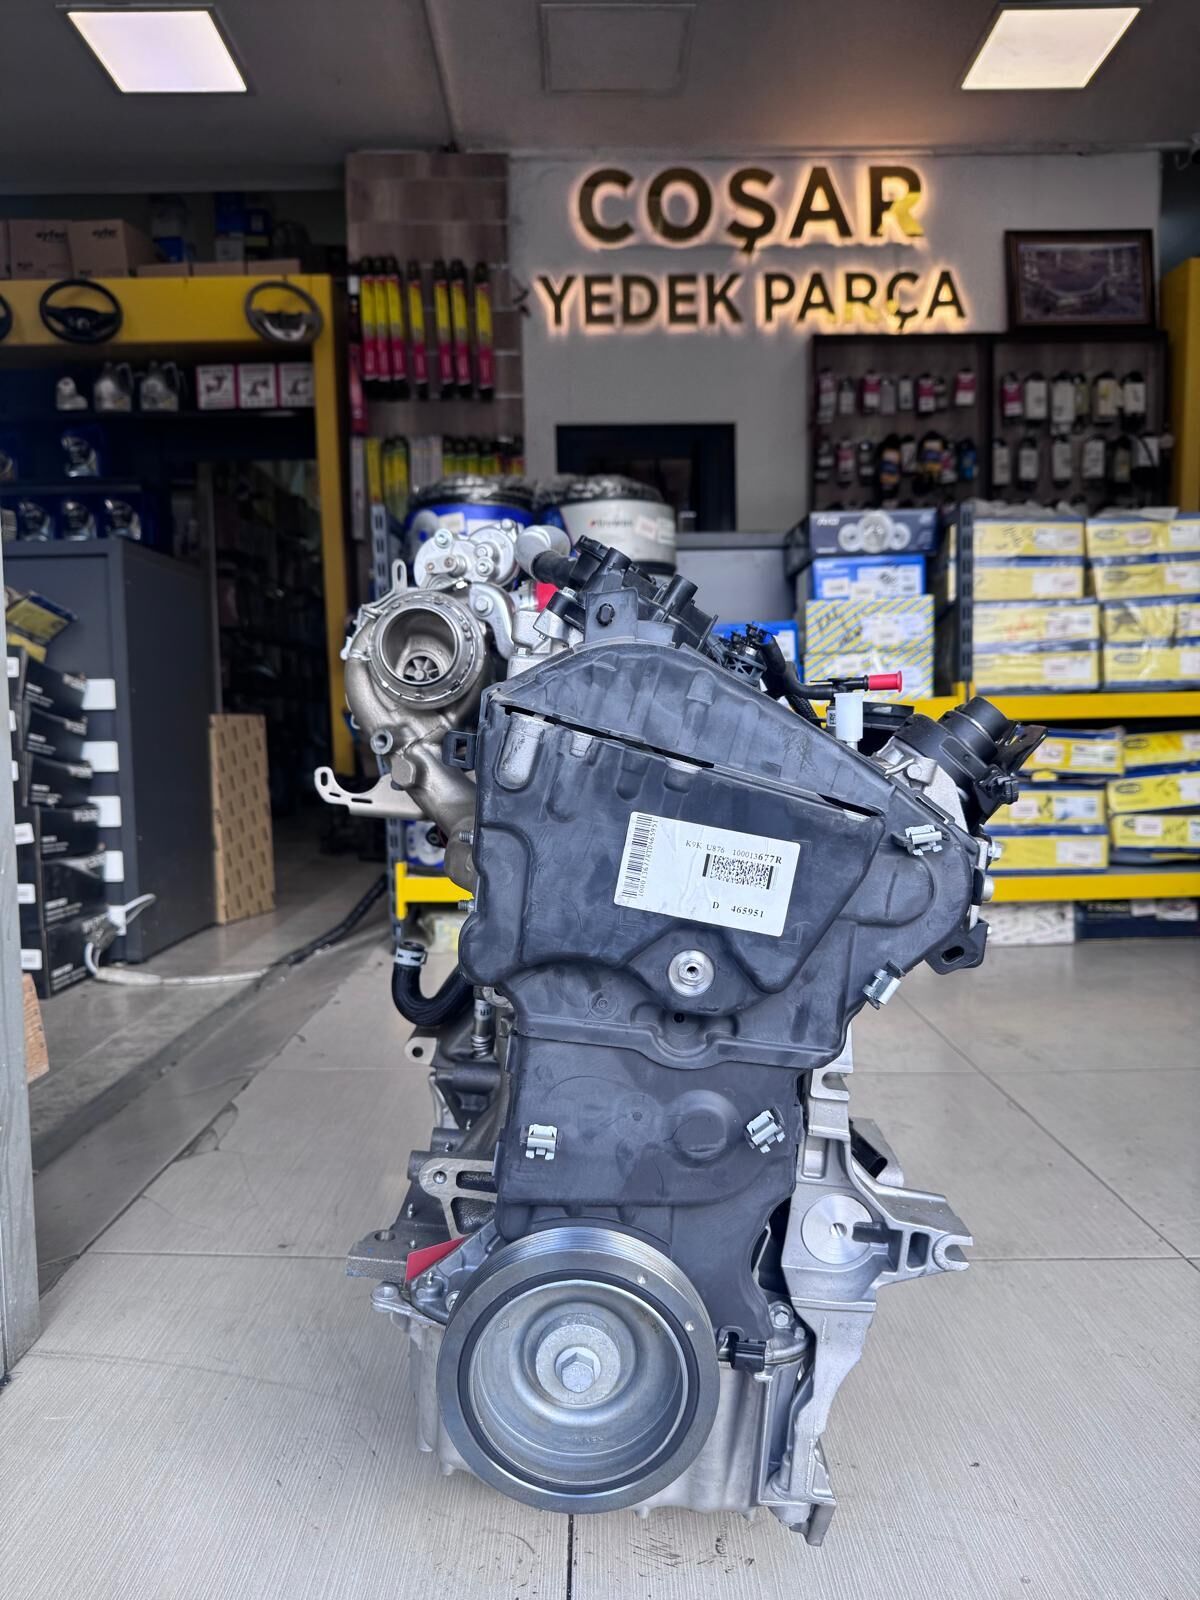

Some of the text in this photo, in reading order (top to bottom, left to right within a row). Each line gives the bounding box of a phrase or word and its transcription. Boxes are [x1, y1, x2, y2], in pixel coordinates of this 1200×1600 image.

[578, 166, 924, 254] COŞAR
[538, 271, 966, 331] YEDEK PARÇA
[685, 840, 703, 850] K9K
[732, 848, 783, 865] 100013677R
[712, 901, 764, 918] D 465951
